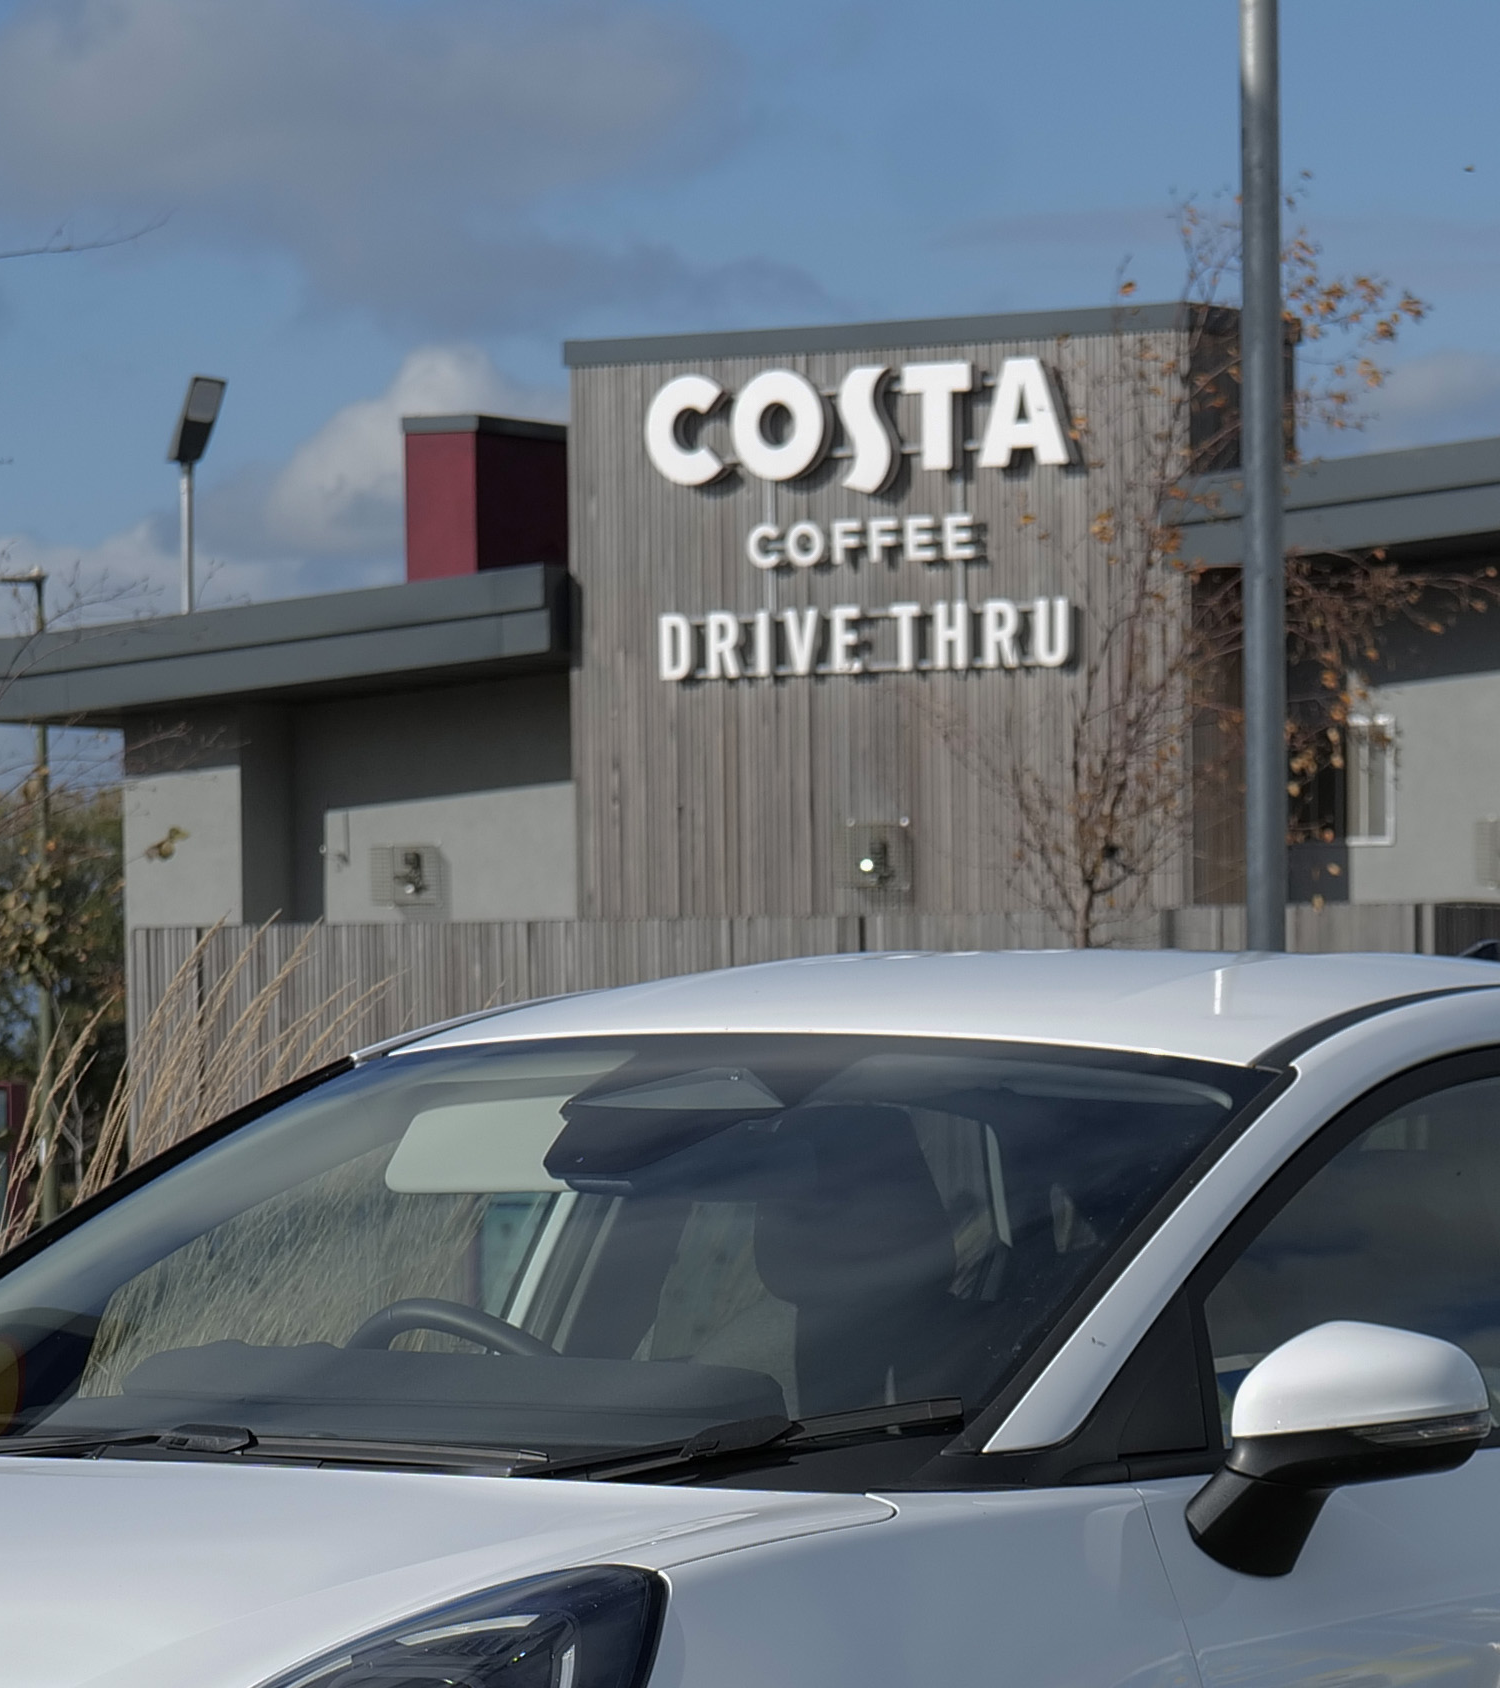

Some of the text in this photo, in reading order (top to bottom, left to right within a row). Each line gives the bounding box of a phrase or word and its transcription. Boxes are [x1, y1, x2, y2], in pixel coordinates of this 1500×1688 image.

[644, 357, 1072, 494] COSTA
[747, 513, 978, 569] COFFEE
[659, 597, 1071, 682] DRIVE THRU
